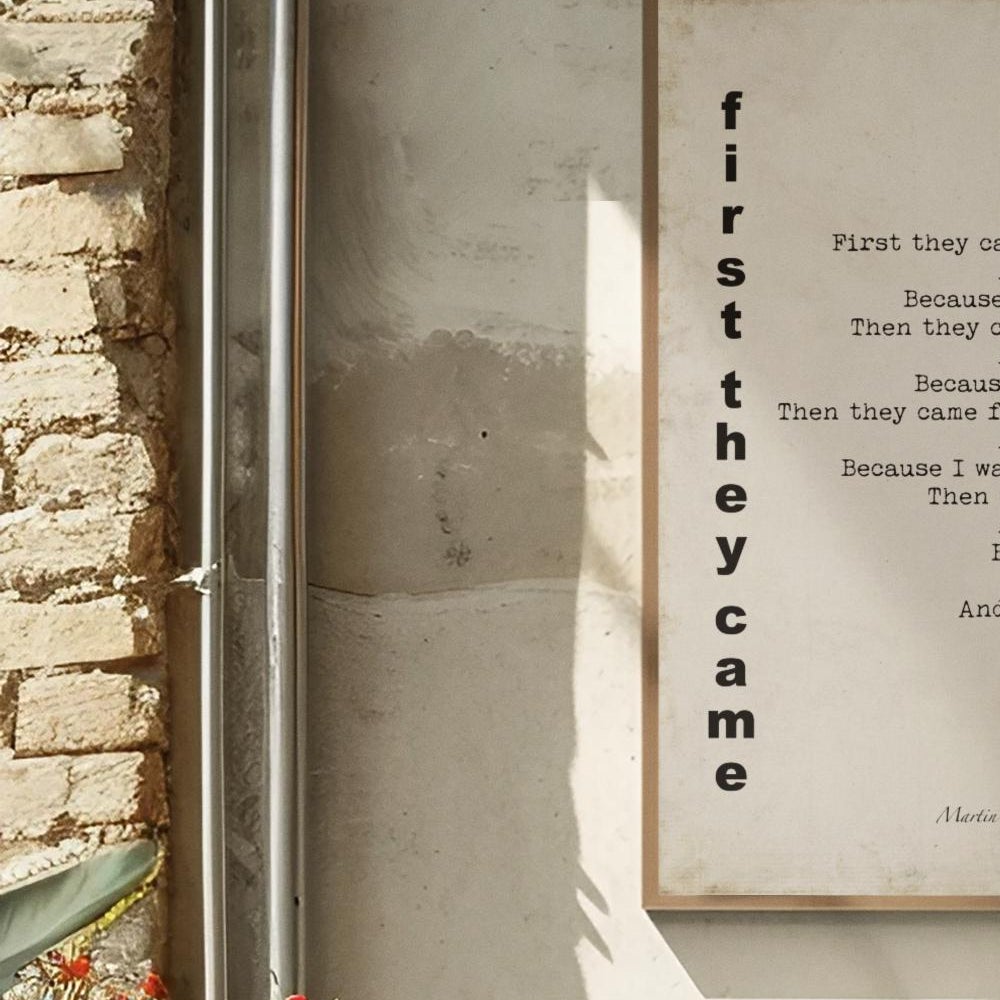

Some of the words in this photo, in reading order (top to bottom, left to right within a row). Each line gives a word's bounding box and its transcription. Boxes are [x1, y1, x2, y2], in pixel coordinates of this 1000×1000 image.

[716, 90, 746, 340] first
[831, 233, 902, 252] First
[911, 233, 969, 256] they
[850, 317, 913, 337] Then
[922, 317, 980, 341] they
[777, 402, 840, 422] Then
[849, 402, 907, 426] they
[917, 406, 978, 422] came
[715, 370, 748, 576] they
[840, 458, 943, 478] Because
[952, 458, 965, 478] I
[927, 486, 989, 506] Then
[708, 605, 755, 792] came
[935, 805, 999, 824] Martin
